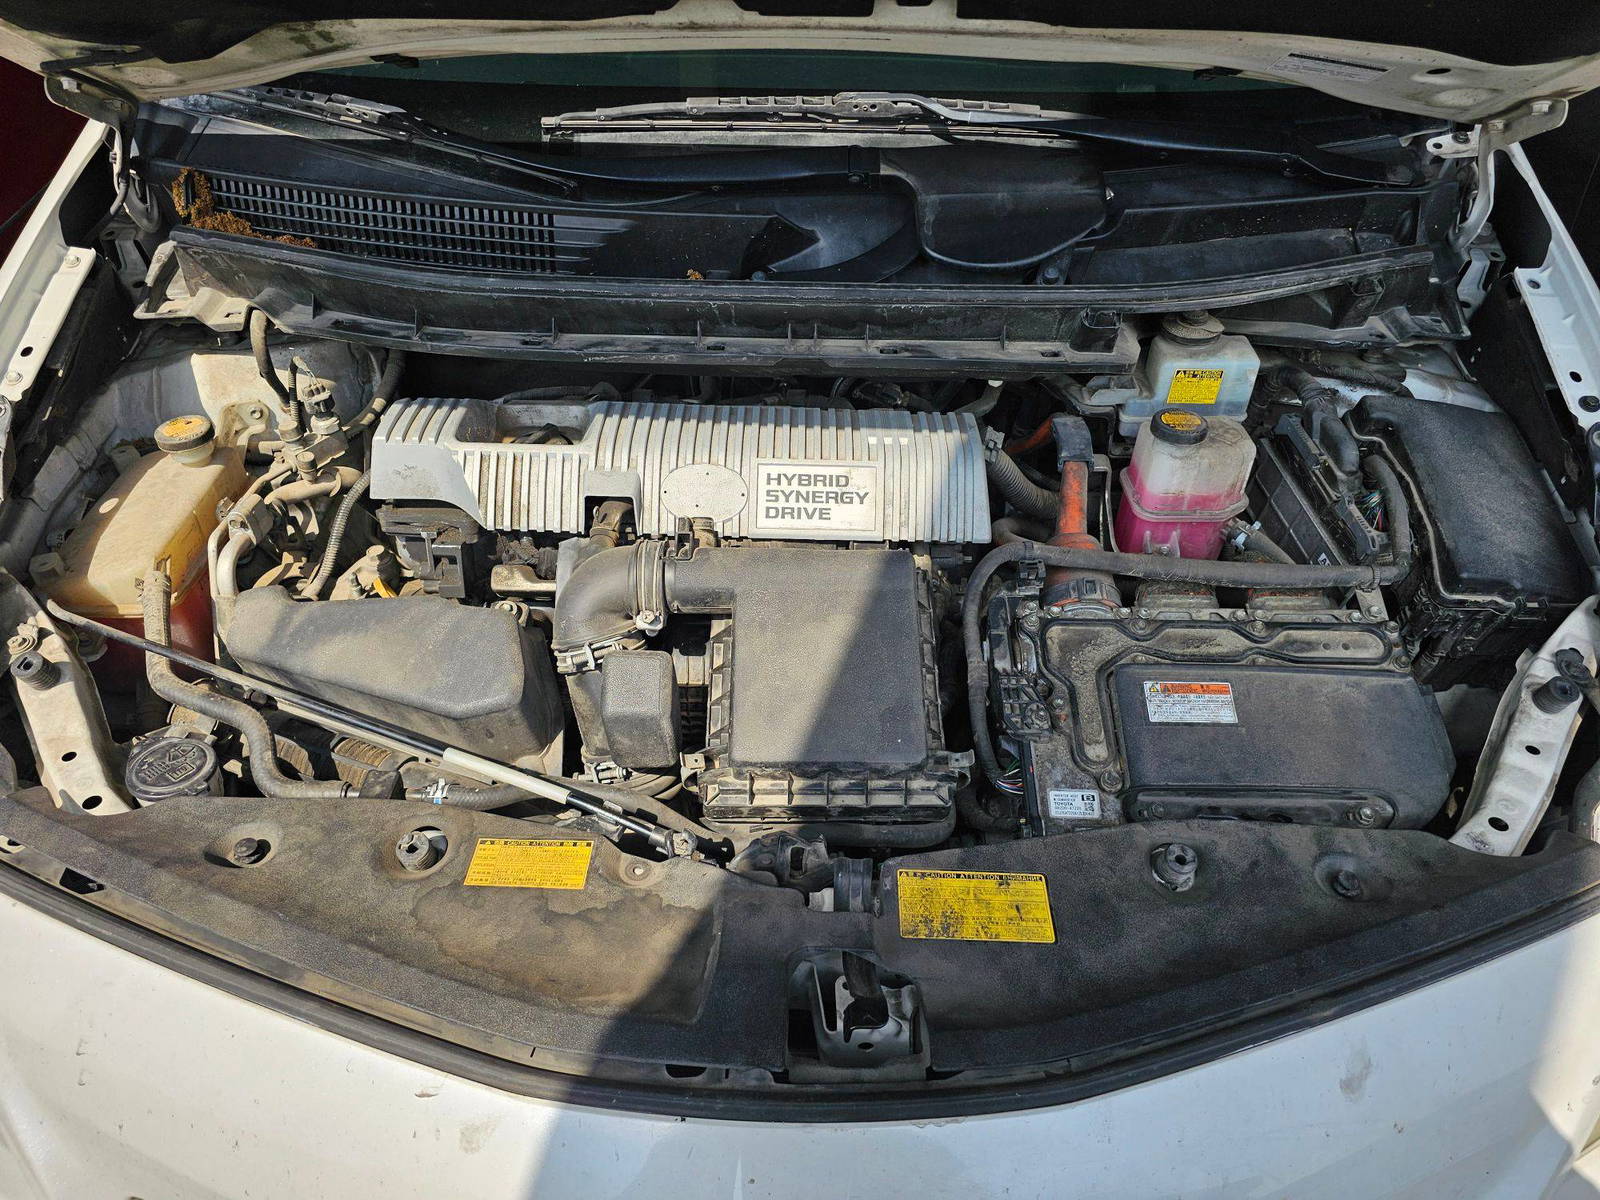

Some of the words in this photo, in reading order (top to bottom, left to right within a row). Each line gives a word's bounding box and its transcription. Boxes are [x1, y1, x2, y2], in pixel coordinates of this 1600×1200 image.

[766, 472, 850, 488] HYBRID
[765, 489, 870, 505] SYNERGY
[765, 506, 832, 521] DRIVE
